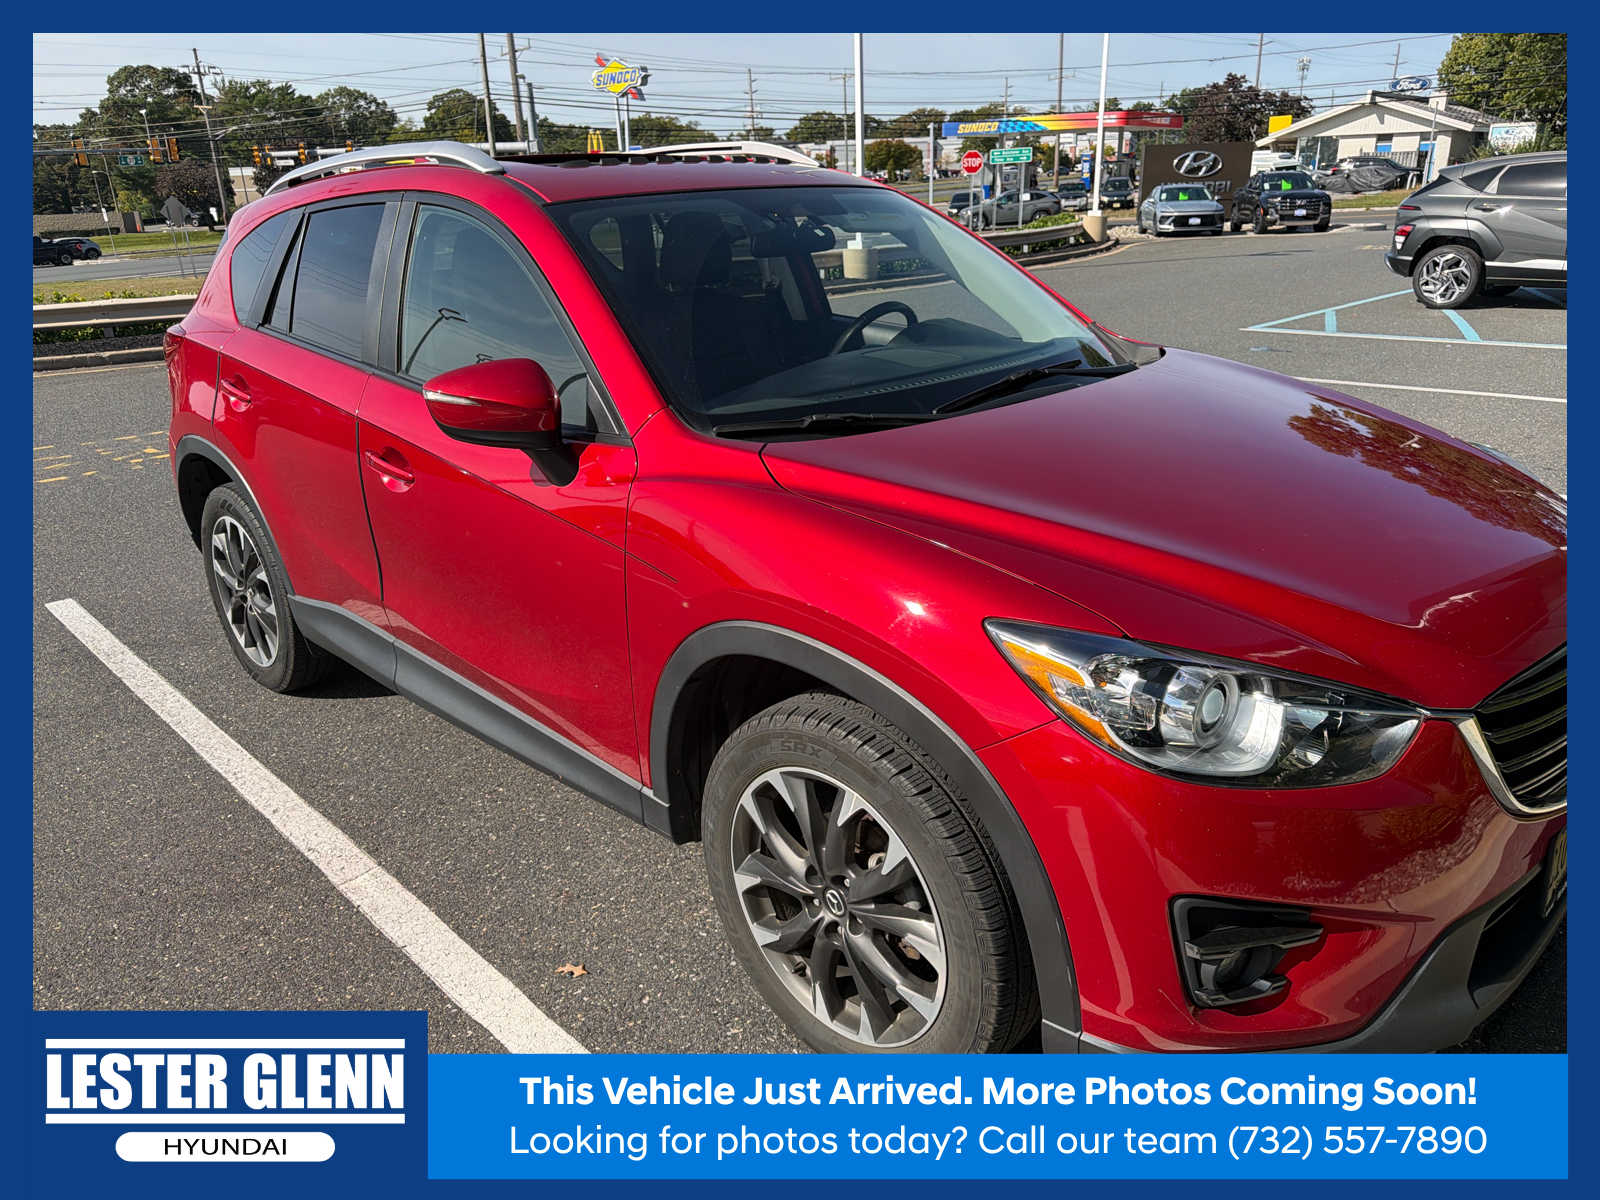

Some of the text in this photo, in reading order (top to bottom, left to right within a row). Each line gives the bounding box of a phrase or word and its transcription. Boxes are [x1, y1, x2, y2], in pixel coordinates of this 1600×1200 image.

[596, 69, 637, 86] SUNOCO
[957, 121, 999, 134] SUNOCO
[962, 157, 982, 168] STOP
